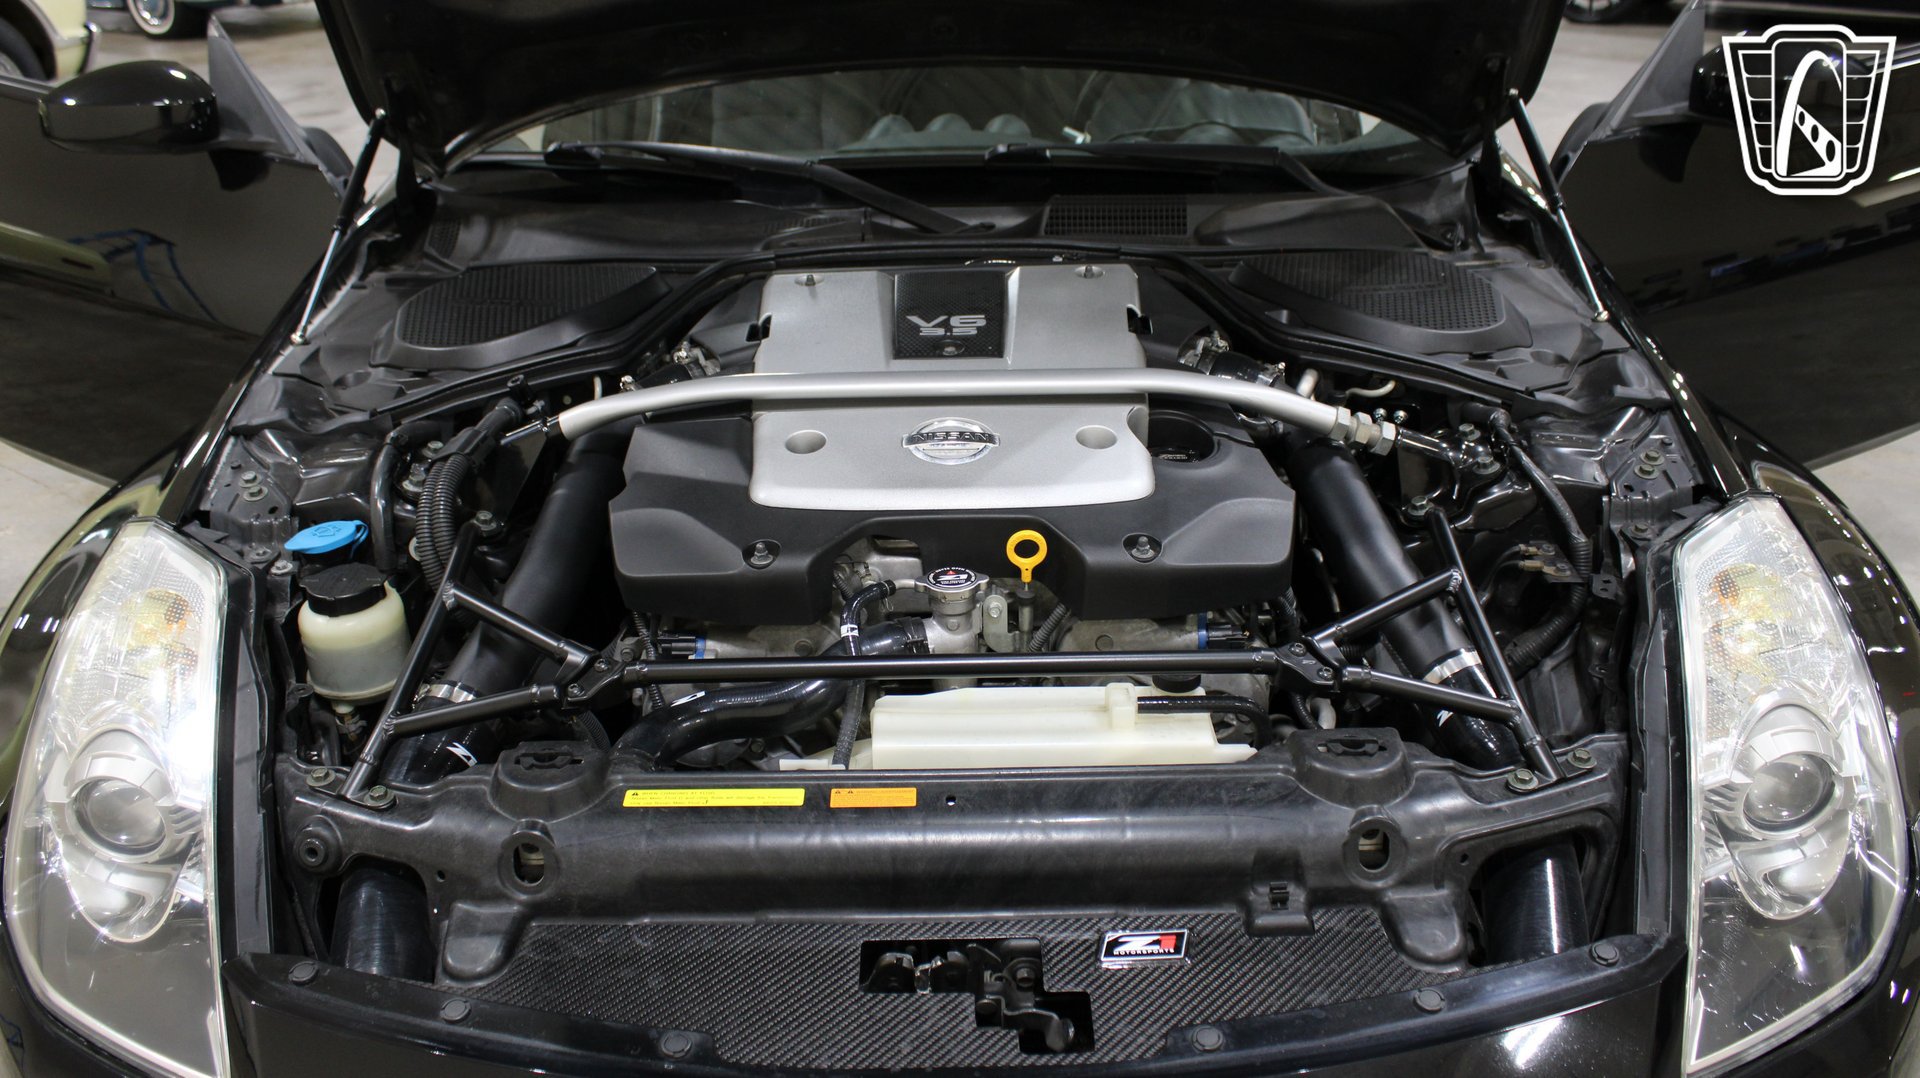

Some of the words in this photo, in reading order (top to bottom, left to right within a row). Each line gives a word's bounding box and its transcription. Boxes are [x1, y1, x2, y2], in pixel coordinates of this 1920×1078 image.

[905, 314, 987, 328] V6
[919, 327, 978, 336] 3.5
[912, 432, 990, 441] NISSAN
[1113, 934, 1177, 951] Z1
[1113, 947, 1175, 956] MOTORSPORTS
